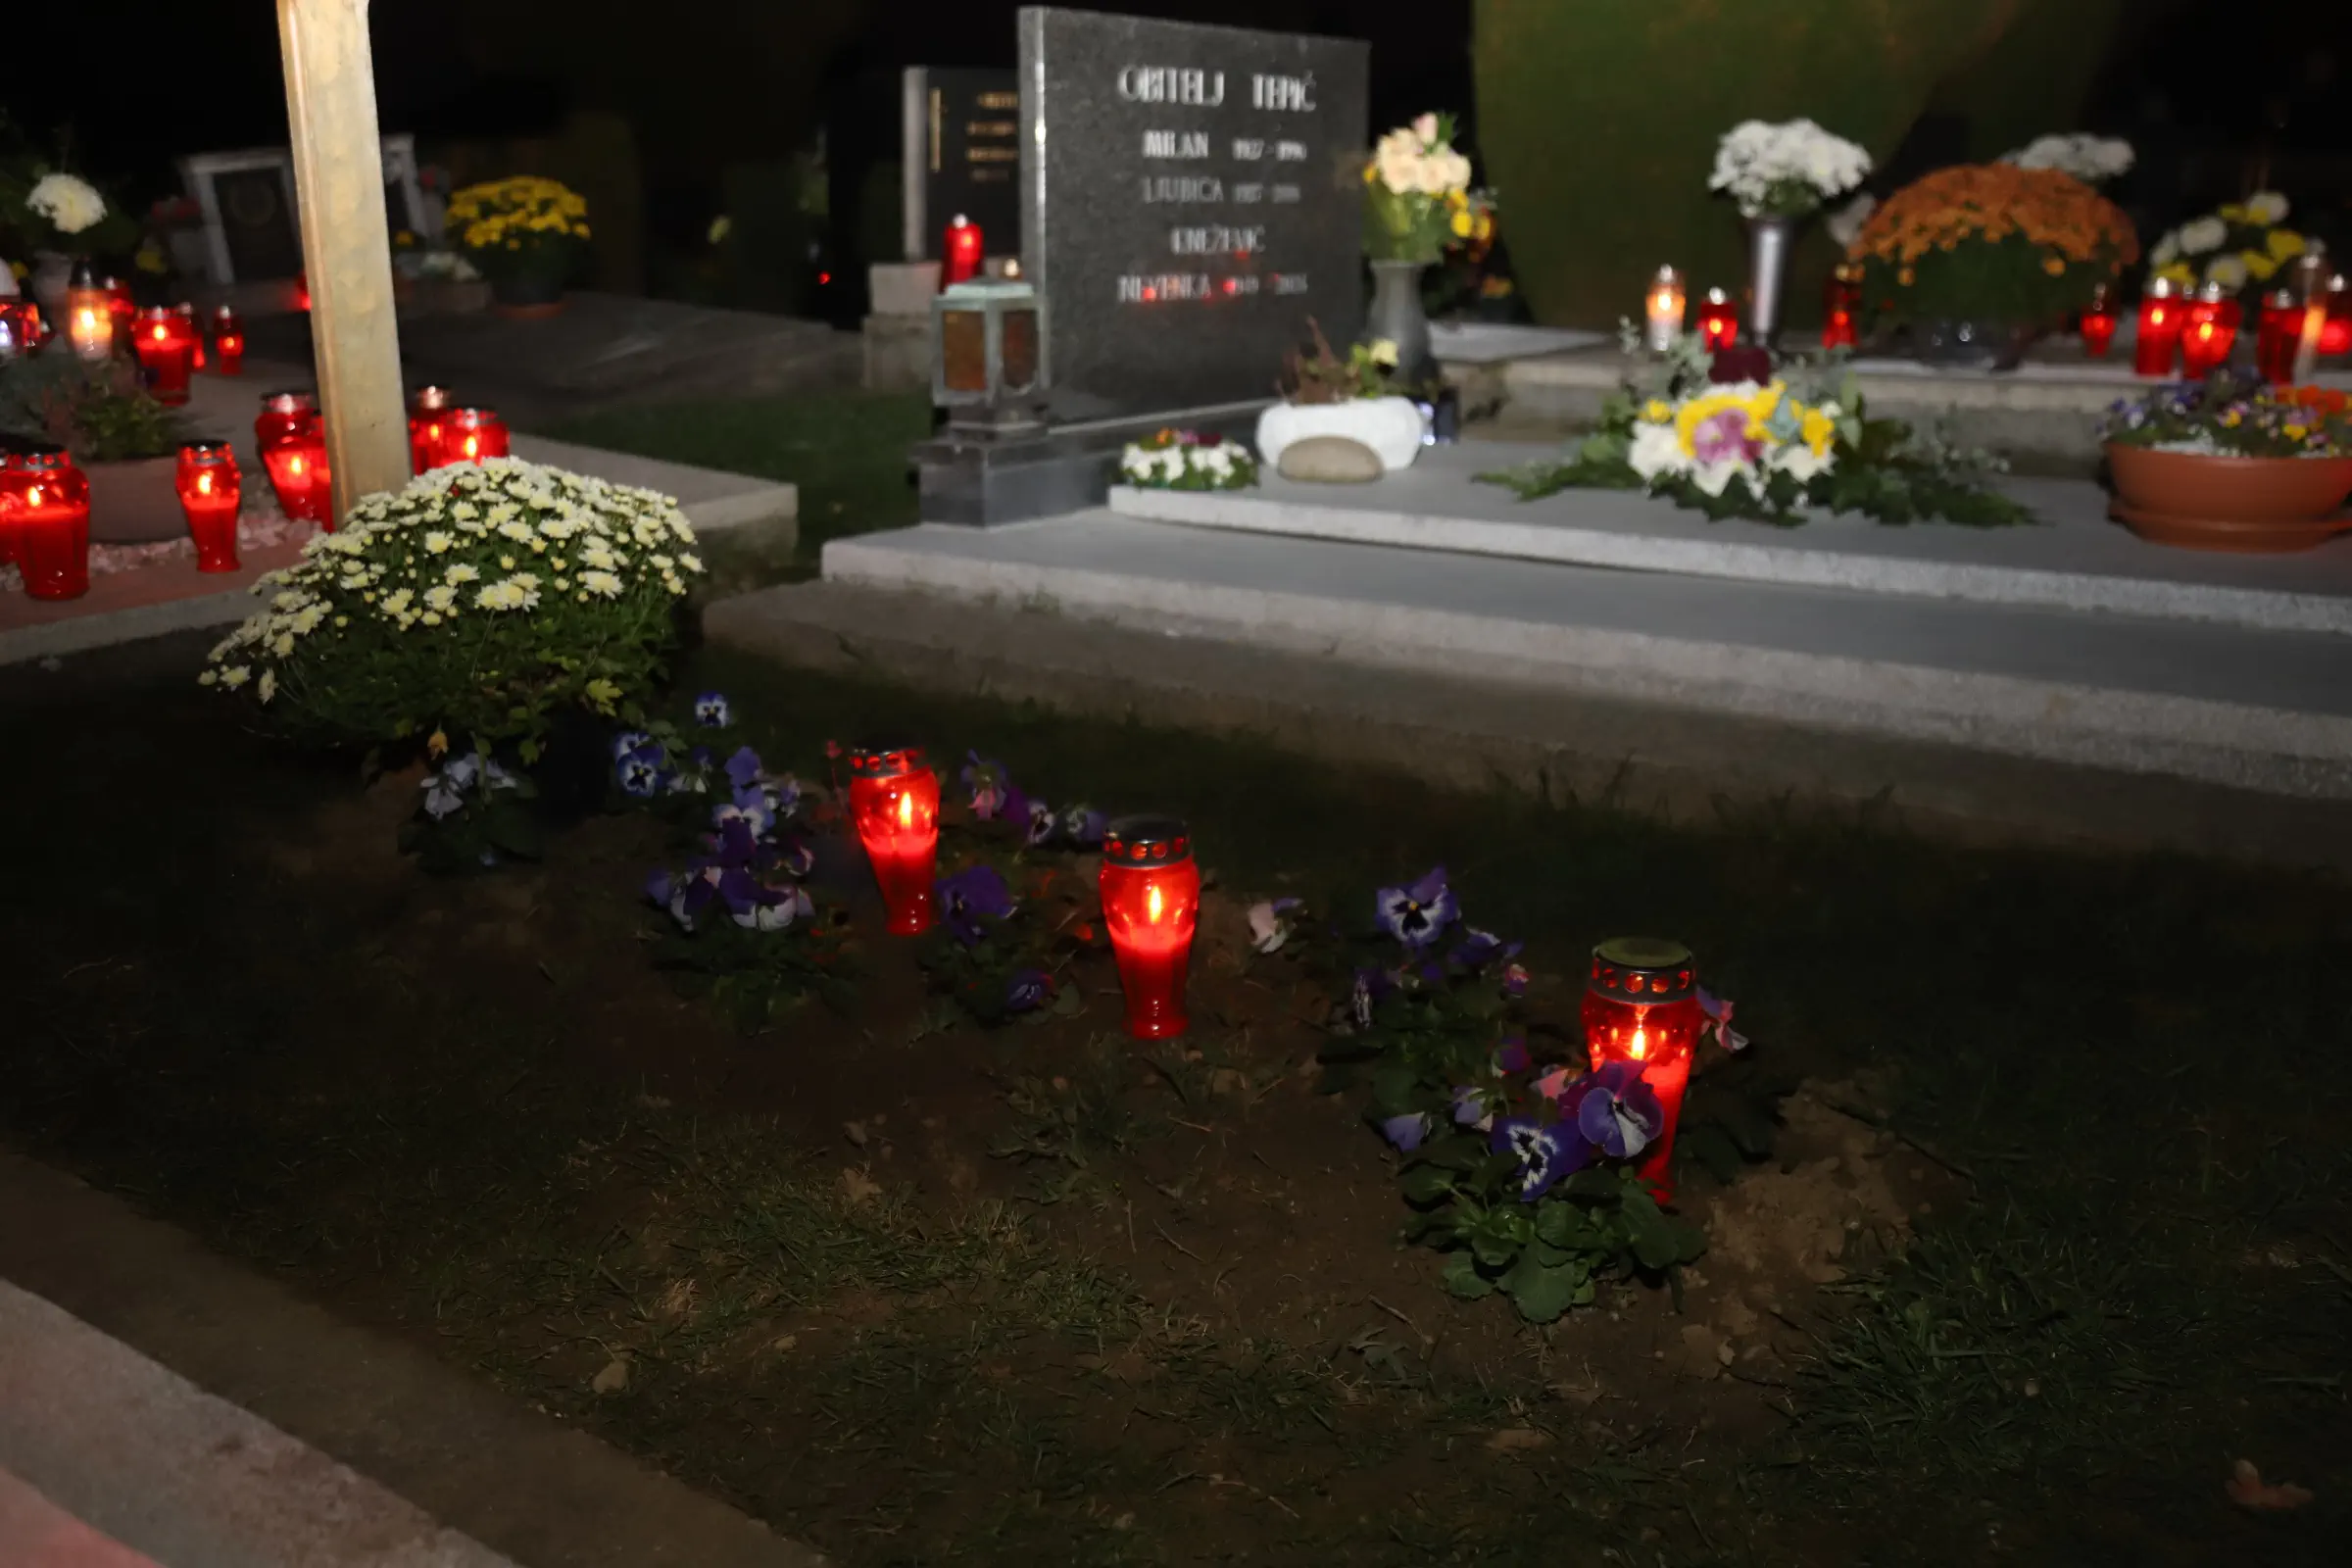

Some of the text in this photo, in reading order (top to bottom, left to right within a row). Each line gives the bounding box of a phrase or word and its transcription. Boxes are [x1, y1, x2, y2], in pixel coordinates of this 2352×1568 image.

[1117, 65, 1224, 106] OBITELJ
[1142, 129, 1208, 159] MILAN
[1141, 176, 1223, 204] LJUBICA
